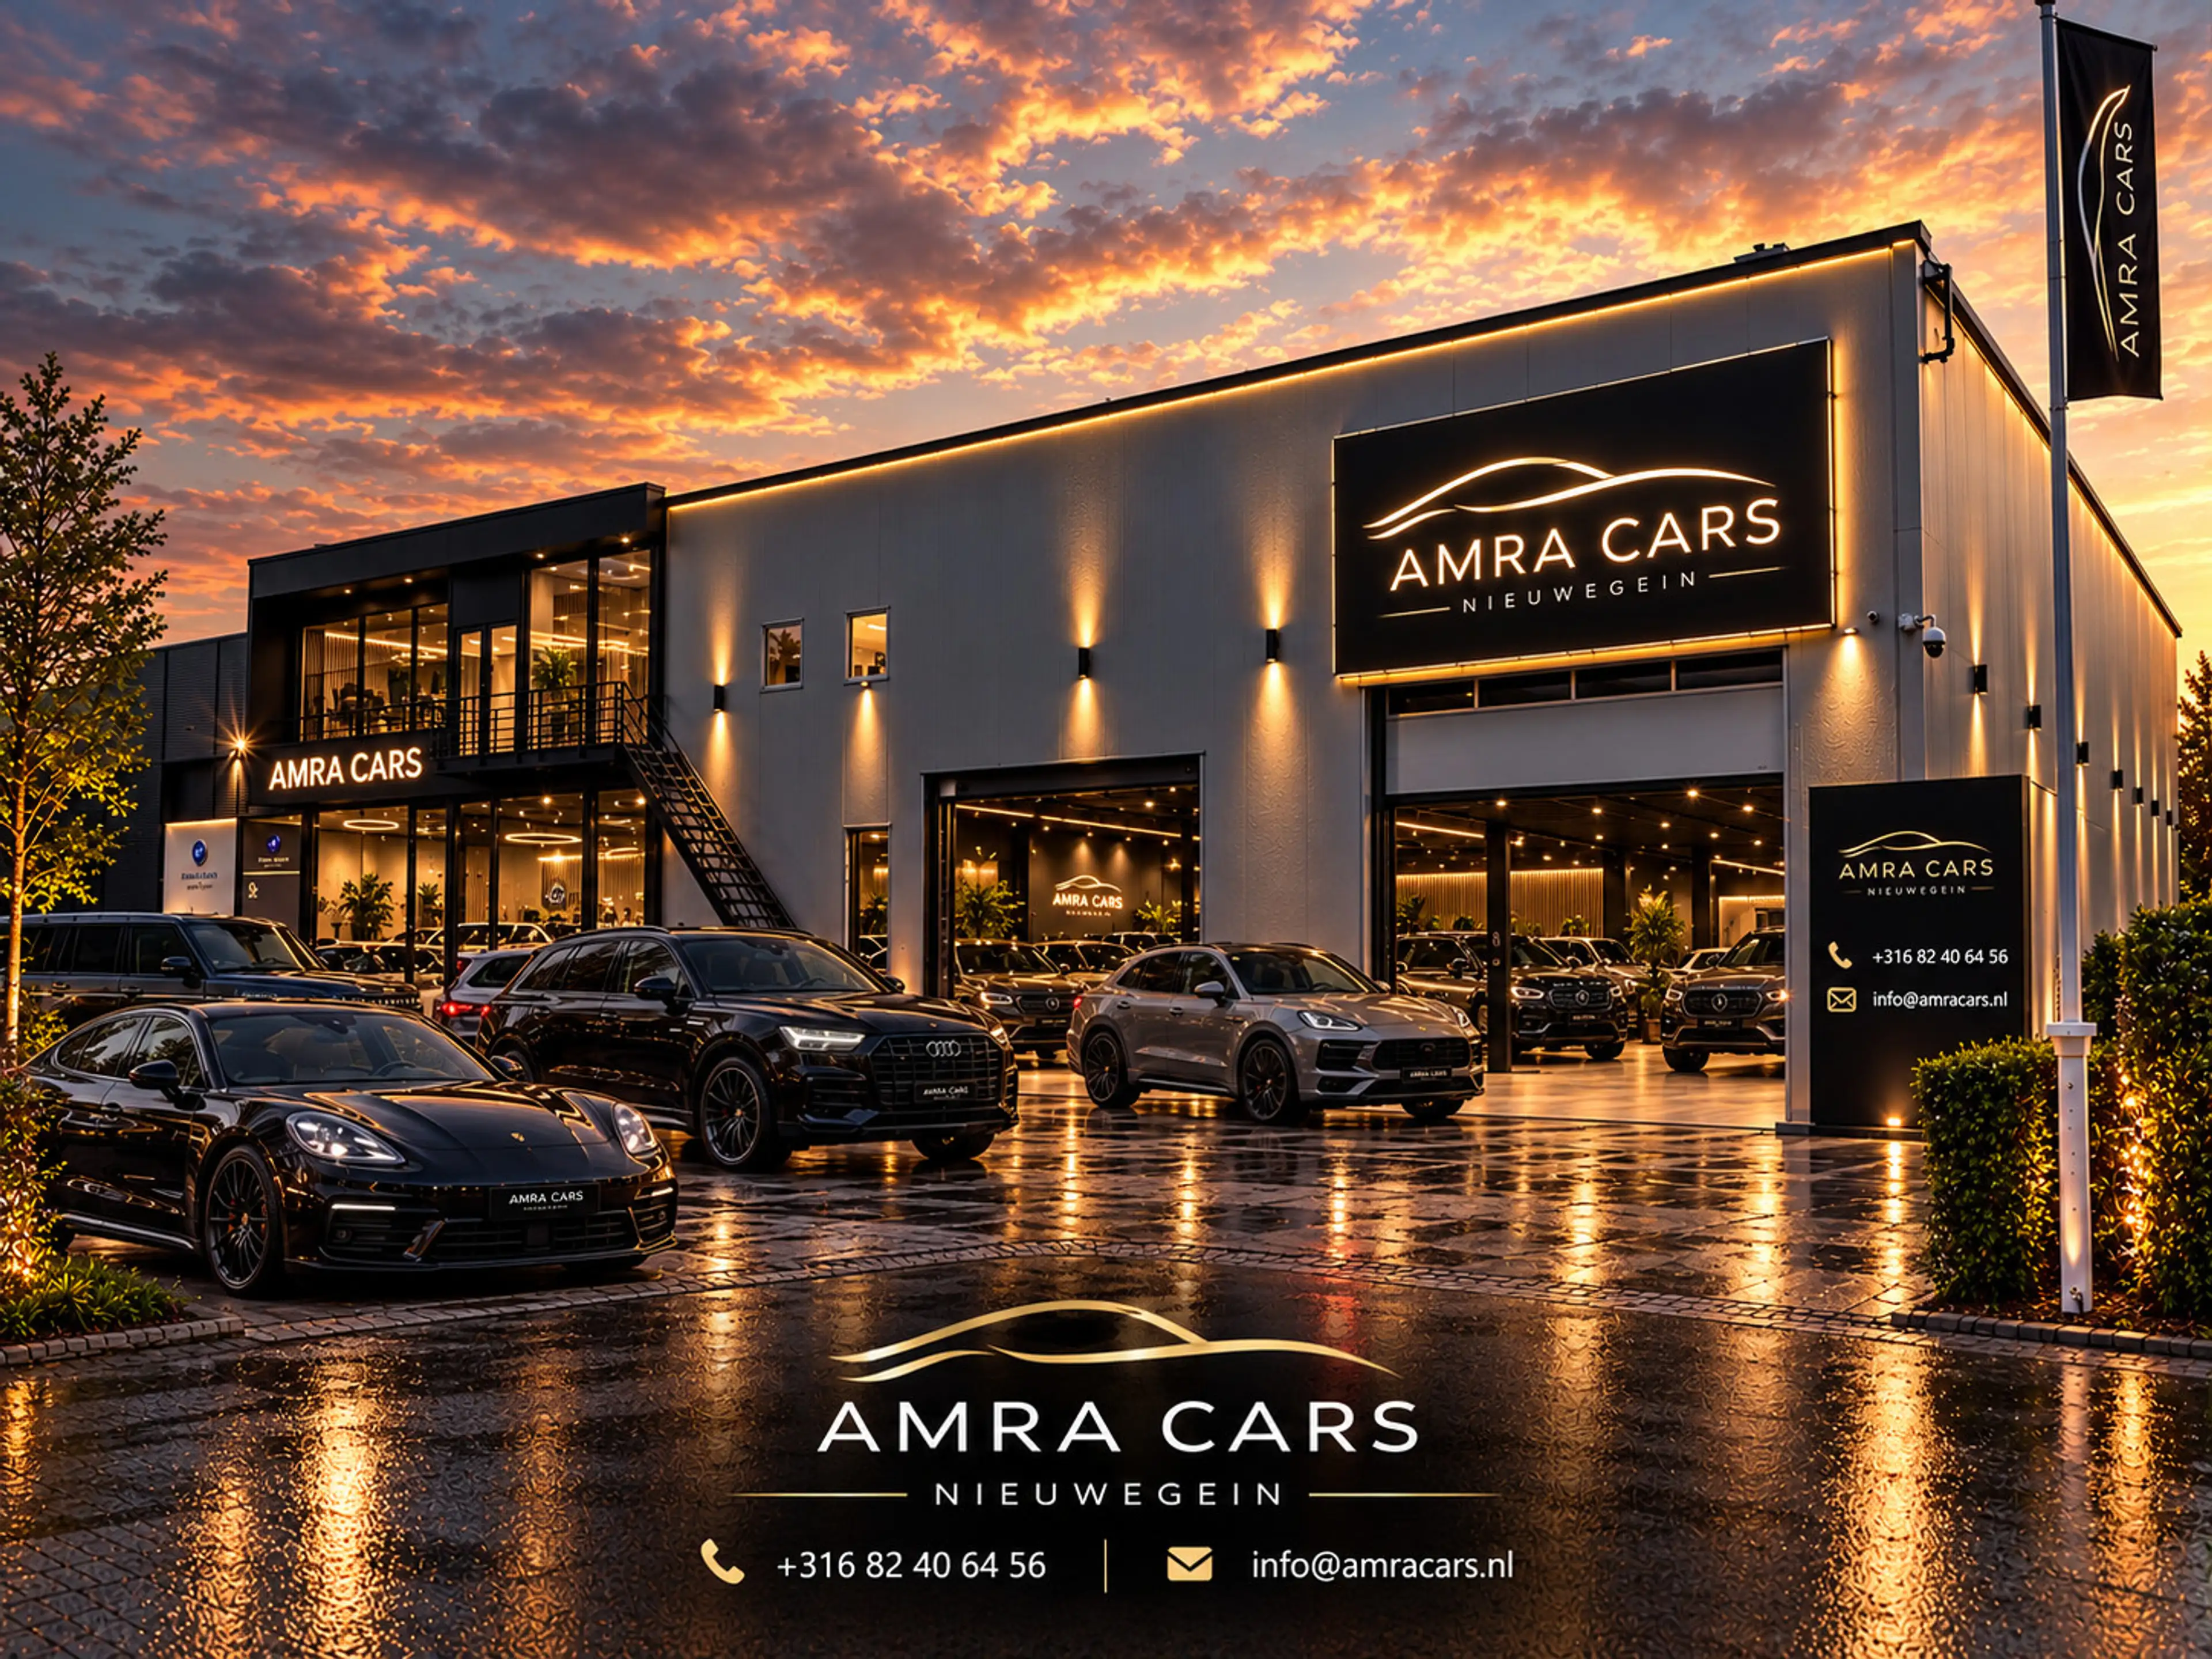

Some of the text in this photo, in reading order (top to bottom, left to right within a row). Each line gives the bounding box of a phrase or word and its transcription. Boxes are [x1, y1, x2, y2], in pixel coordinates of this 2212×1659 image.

[2113, 121, 2140, 358] AMRA CARS
[1389, 497, 1782, 592] AMRA CARS
[1463, 571, 1695, 613] NIEUWEGEIN
[268, 747, 423, 791] AMRA CARS
[1838, 858, 1994, 880] AMRA CARS
[1052, 893, 1089, 907] AMRA
[1867, 885, 1965, 896] NIEUWEGEIN
[1872, 948, 2009, 964] +316 82 40 64 56
[1873, 990, 2008, 1009] info@amracars.nl
[509, 1190, 584, 1205] AMRA CARS
